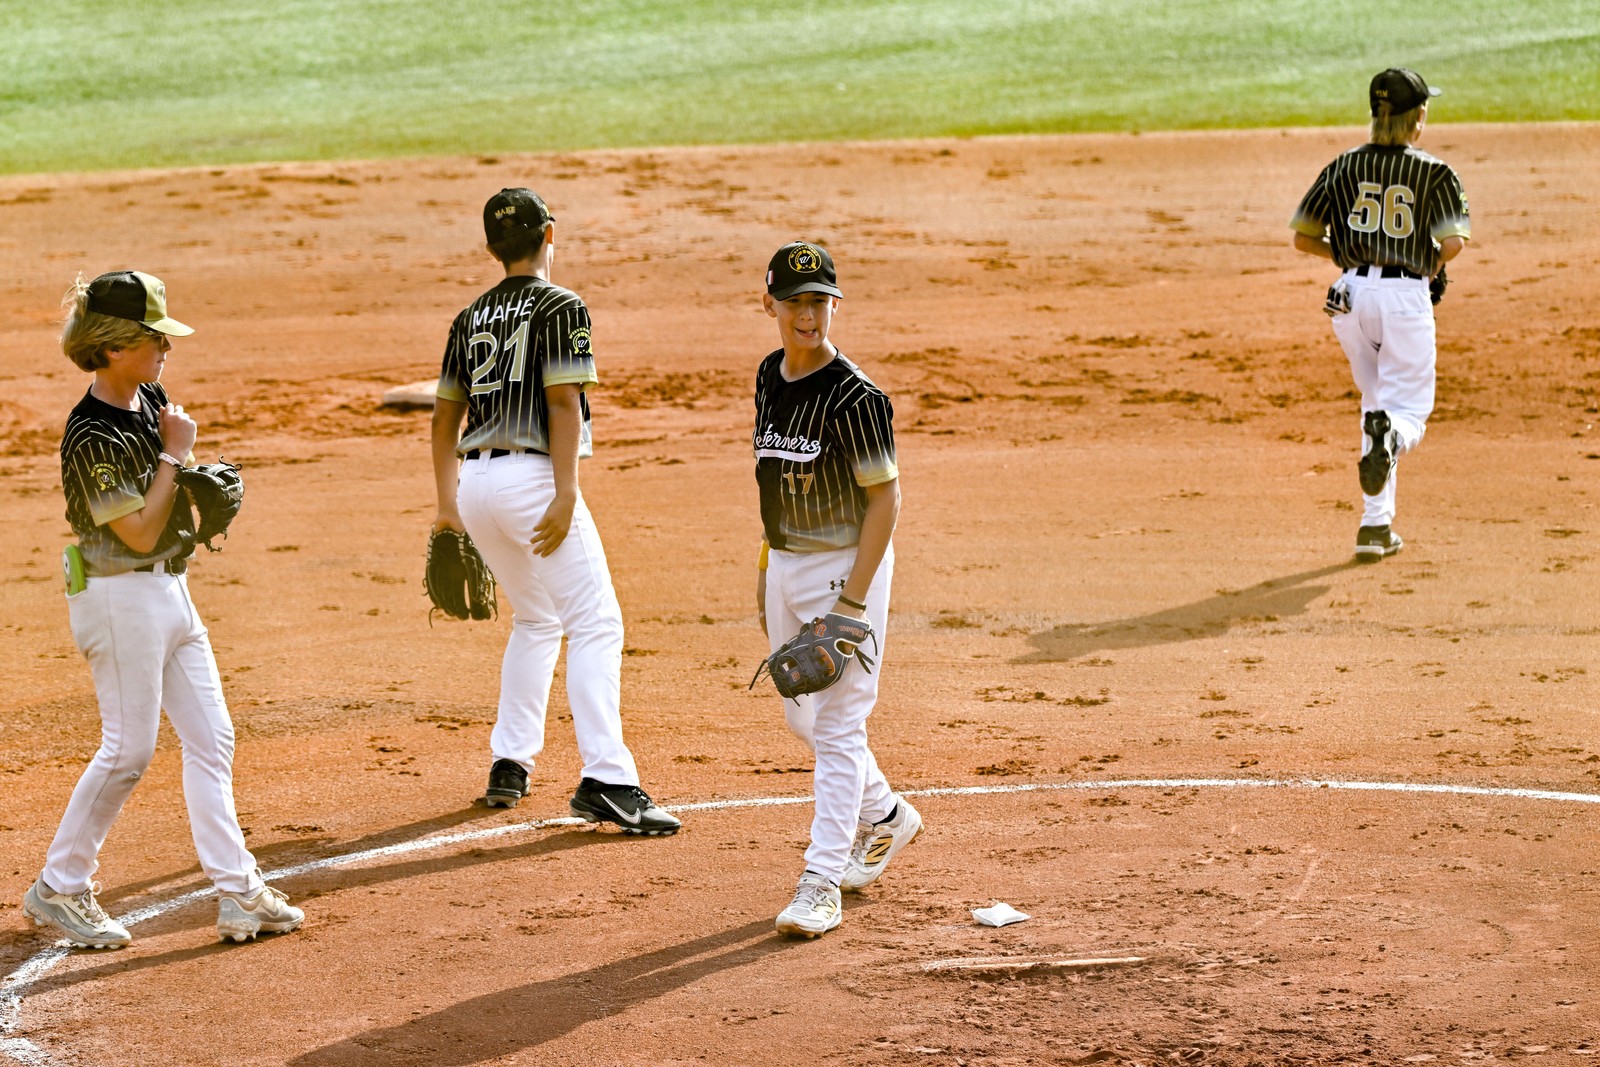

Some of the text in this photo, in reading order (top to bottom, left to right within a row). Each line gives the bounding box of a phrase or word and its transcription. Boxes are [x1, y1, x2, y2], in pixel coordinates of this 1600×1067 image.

[1347, 181, 1415, 239] 56
[472, 296, 536, 330] MAHE
[468, 320, 529, 397] 21
[783, 471, 814, 495] 17
